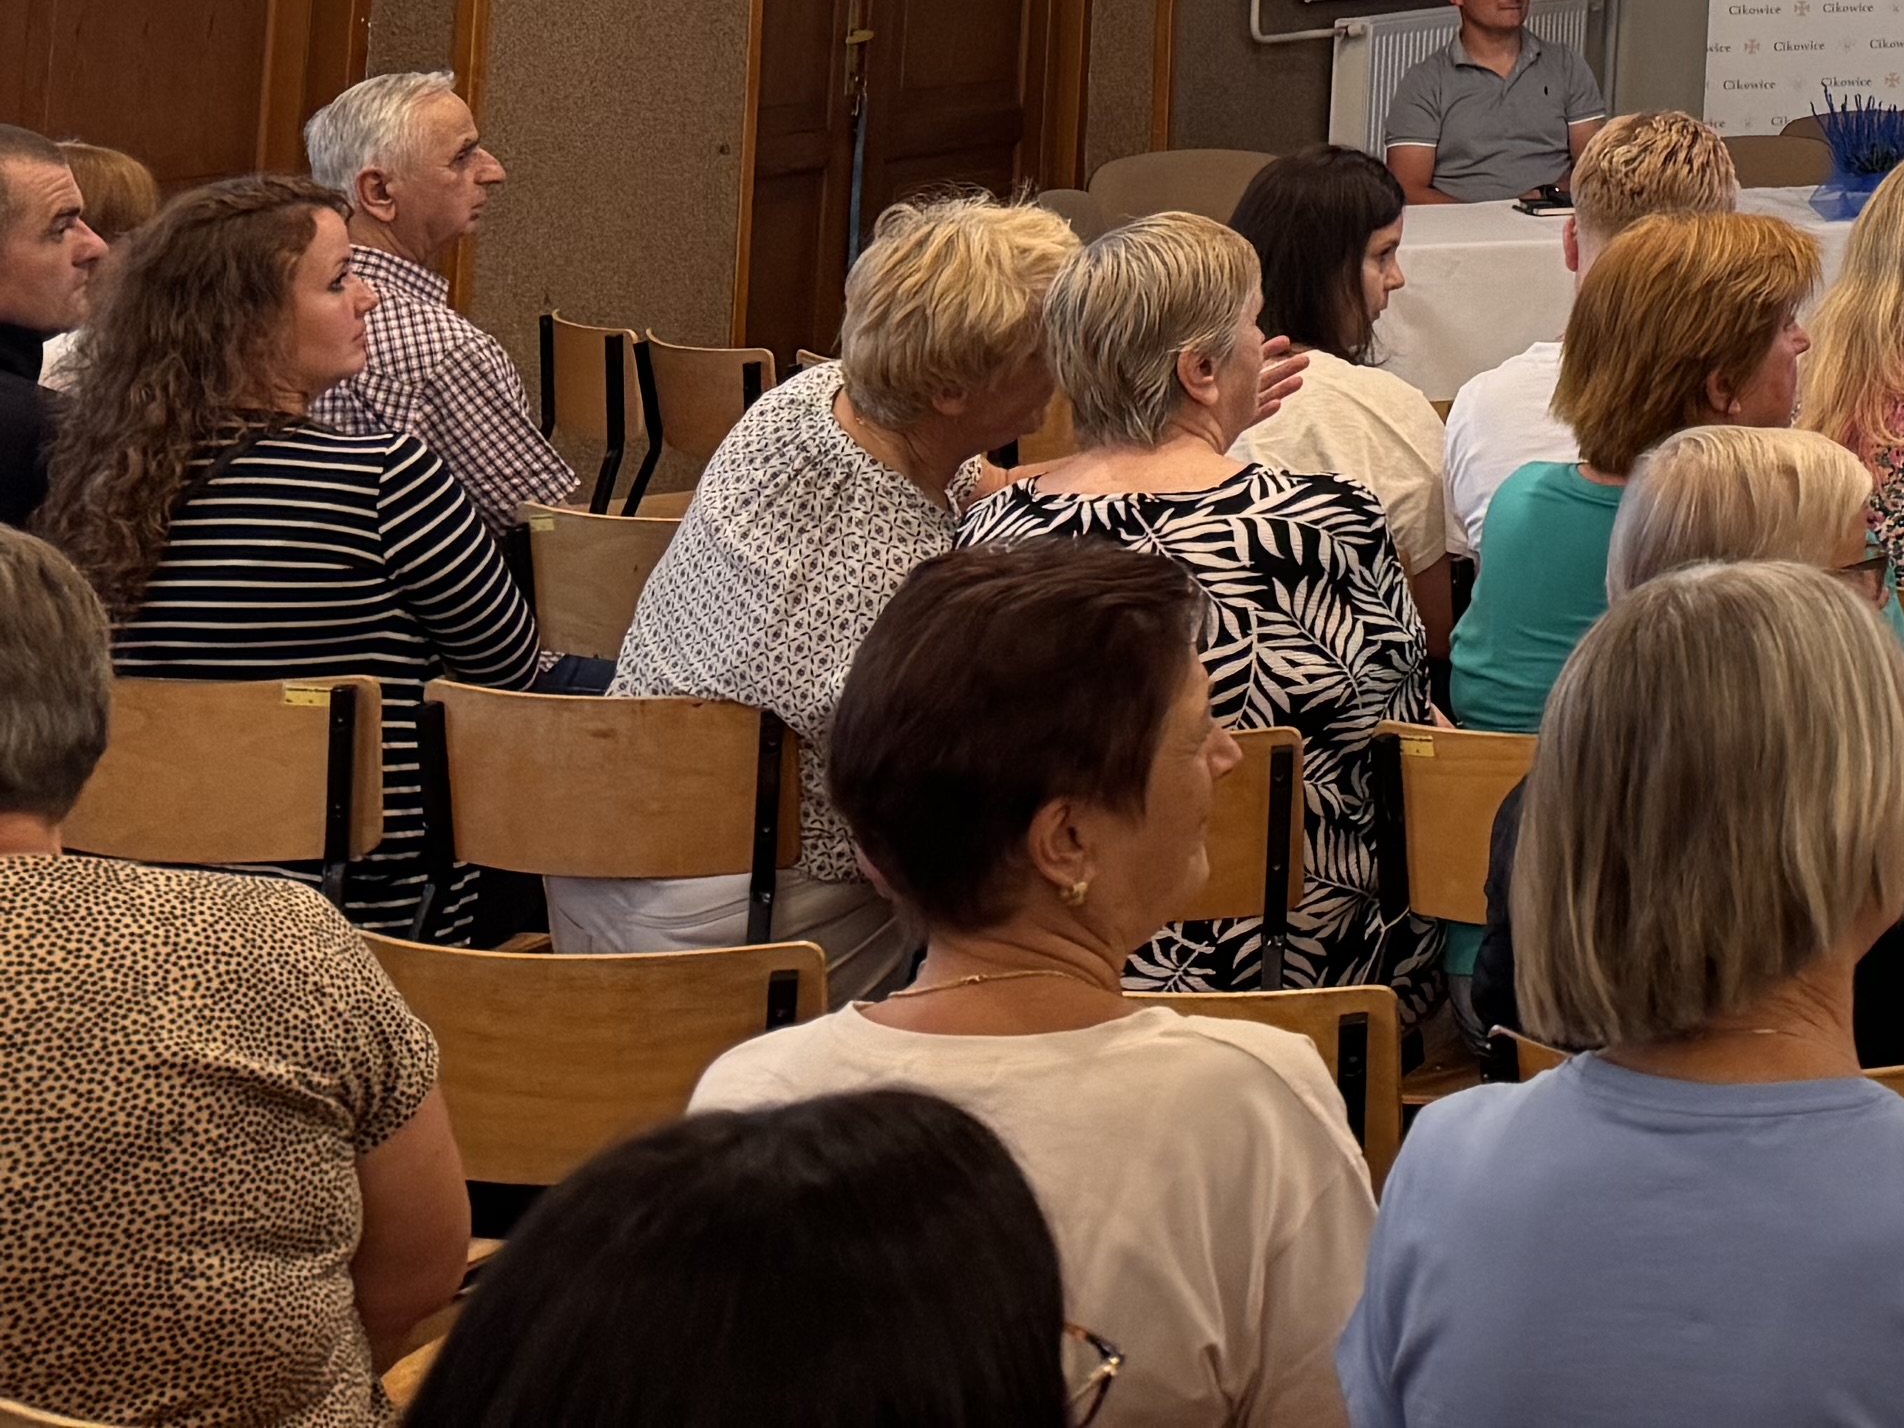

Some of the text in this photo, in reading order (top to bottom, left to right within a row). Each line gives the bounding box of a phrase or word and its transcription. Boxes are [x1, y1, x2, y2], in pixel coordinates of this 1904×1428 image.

[1728, 4, 1782, 16] Cikowice
[1822, 1, 1874, 13] Cikowice
[1773, 39, 1825, 52] Cikowice
[1722, 79, 1776, 91] Cikowice
